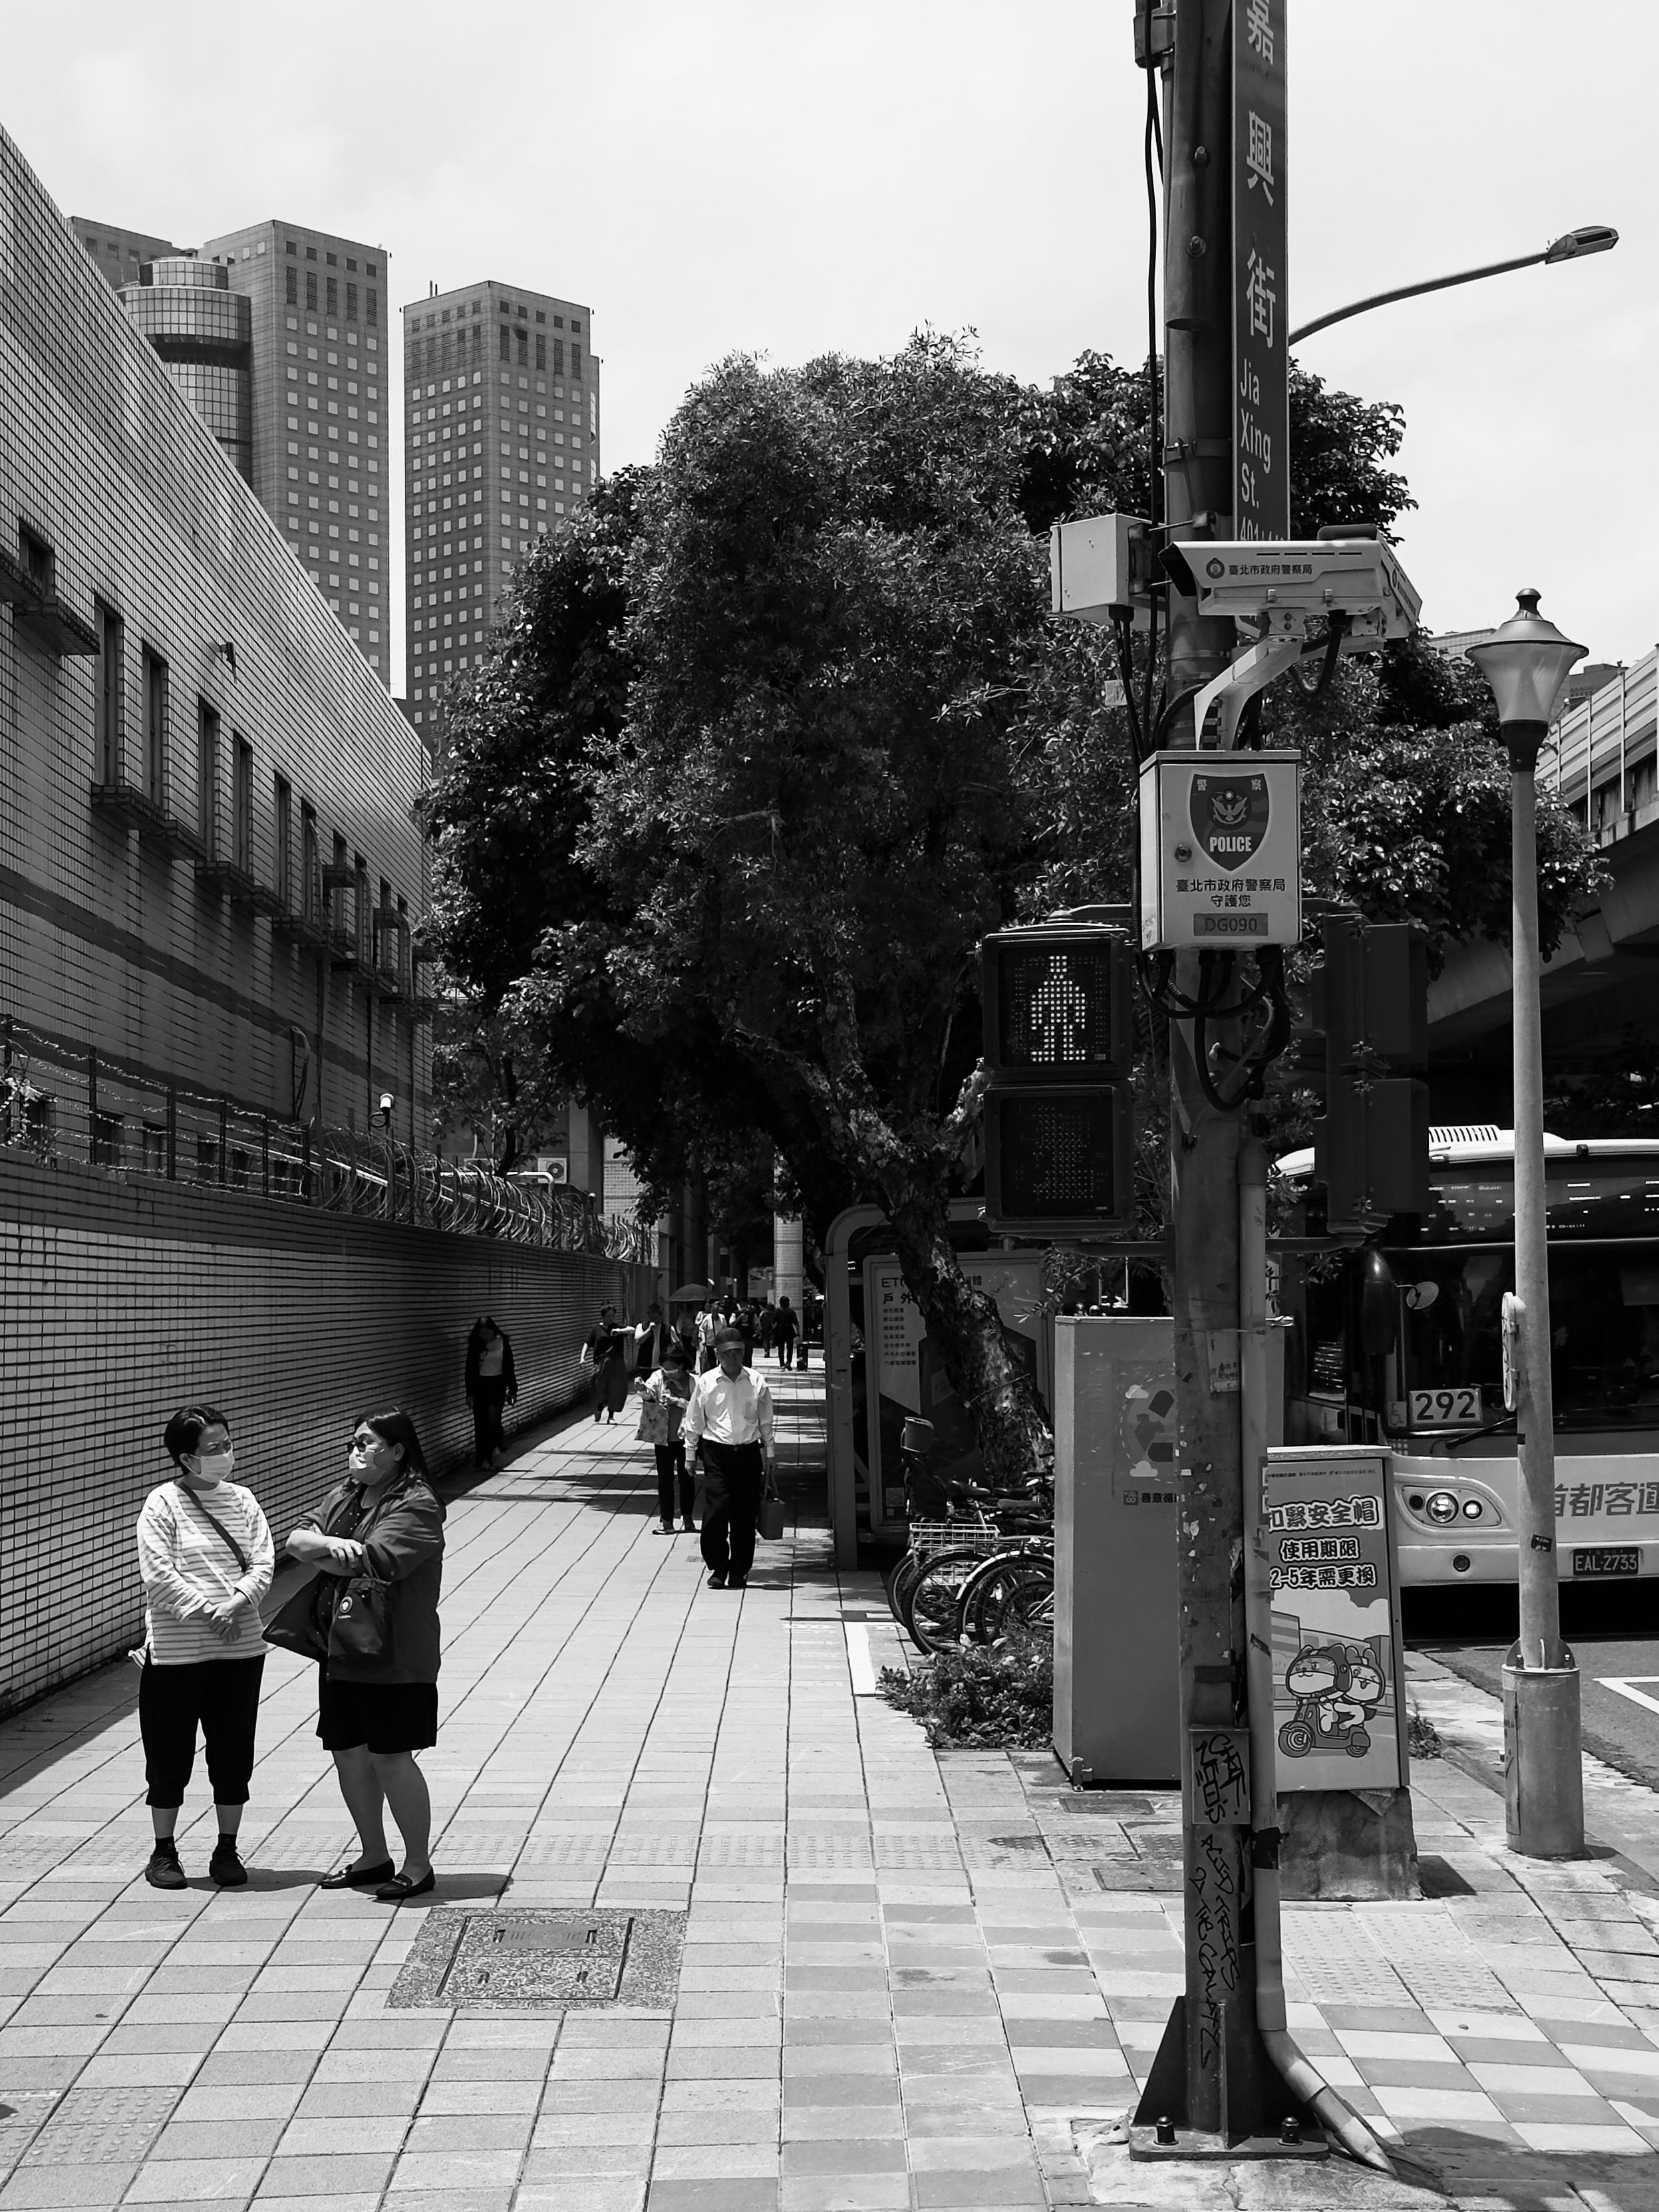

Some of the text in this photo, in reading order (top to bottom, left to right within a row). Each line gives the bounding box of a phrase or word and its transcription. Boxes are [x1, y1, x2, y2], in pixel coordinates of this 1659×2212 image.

[1246, 0, 1276, 348] 嘉興街
[1241, 358, 1260, 406] Jia
[1241, 408, 1271, 474] Xing
[1241, 462, 1259, 509] St.
[1229, 564, 1312, 576] 臺北市政府警察局
[1209, 836, 1252, 852] POLICE
[1176, 879, 1286, 893] 臺北市政府警察局
[1211, 895, 1251, 908] 守護您
[1204, 917, 1258, 932] DG090
[1415, 1391, 1476, 1421] 292
[1282, 1538, 1357, 1560] 使用期限
